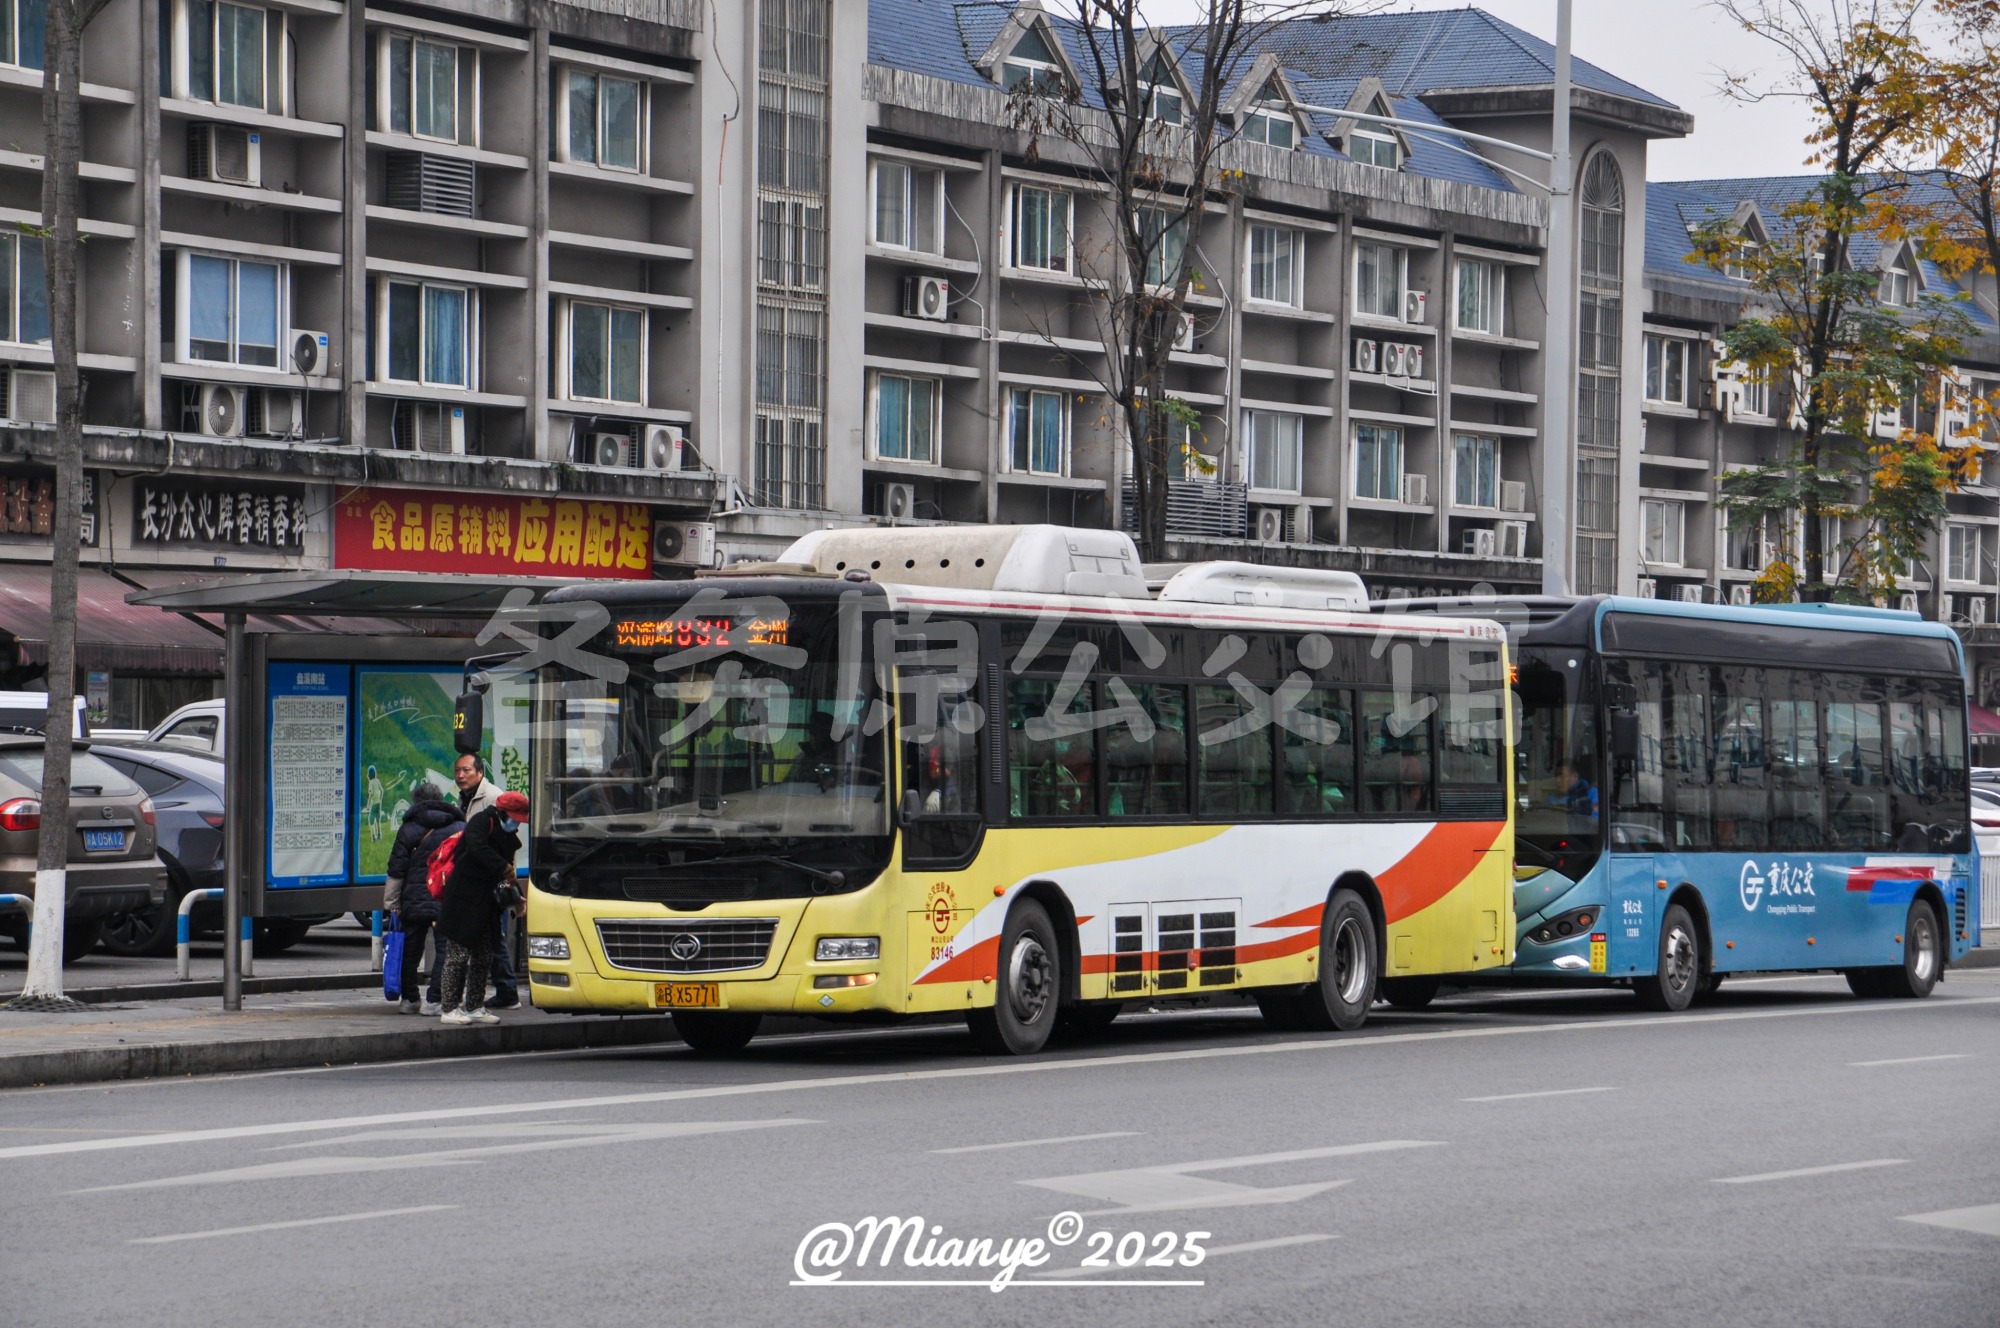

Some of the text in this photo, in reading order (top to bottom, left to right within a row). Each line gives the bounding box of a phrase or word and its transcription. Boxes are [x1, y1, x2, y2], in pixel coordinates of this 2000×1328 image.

[142, 487, 307, 546] 长沙众心牌香精香料
[370, 498, 649, 570] 食品原辅料应用配送
[1767, 861, 1815, 896] 重庆公交
[1623, 900, 1643, 914] 重庆公交
[930, 945, 954, 961] 83146
